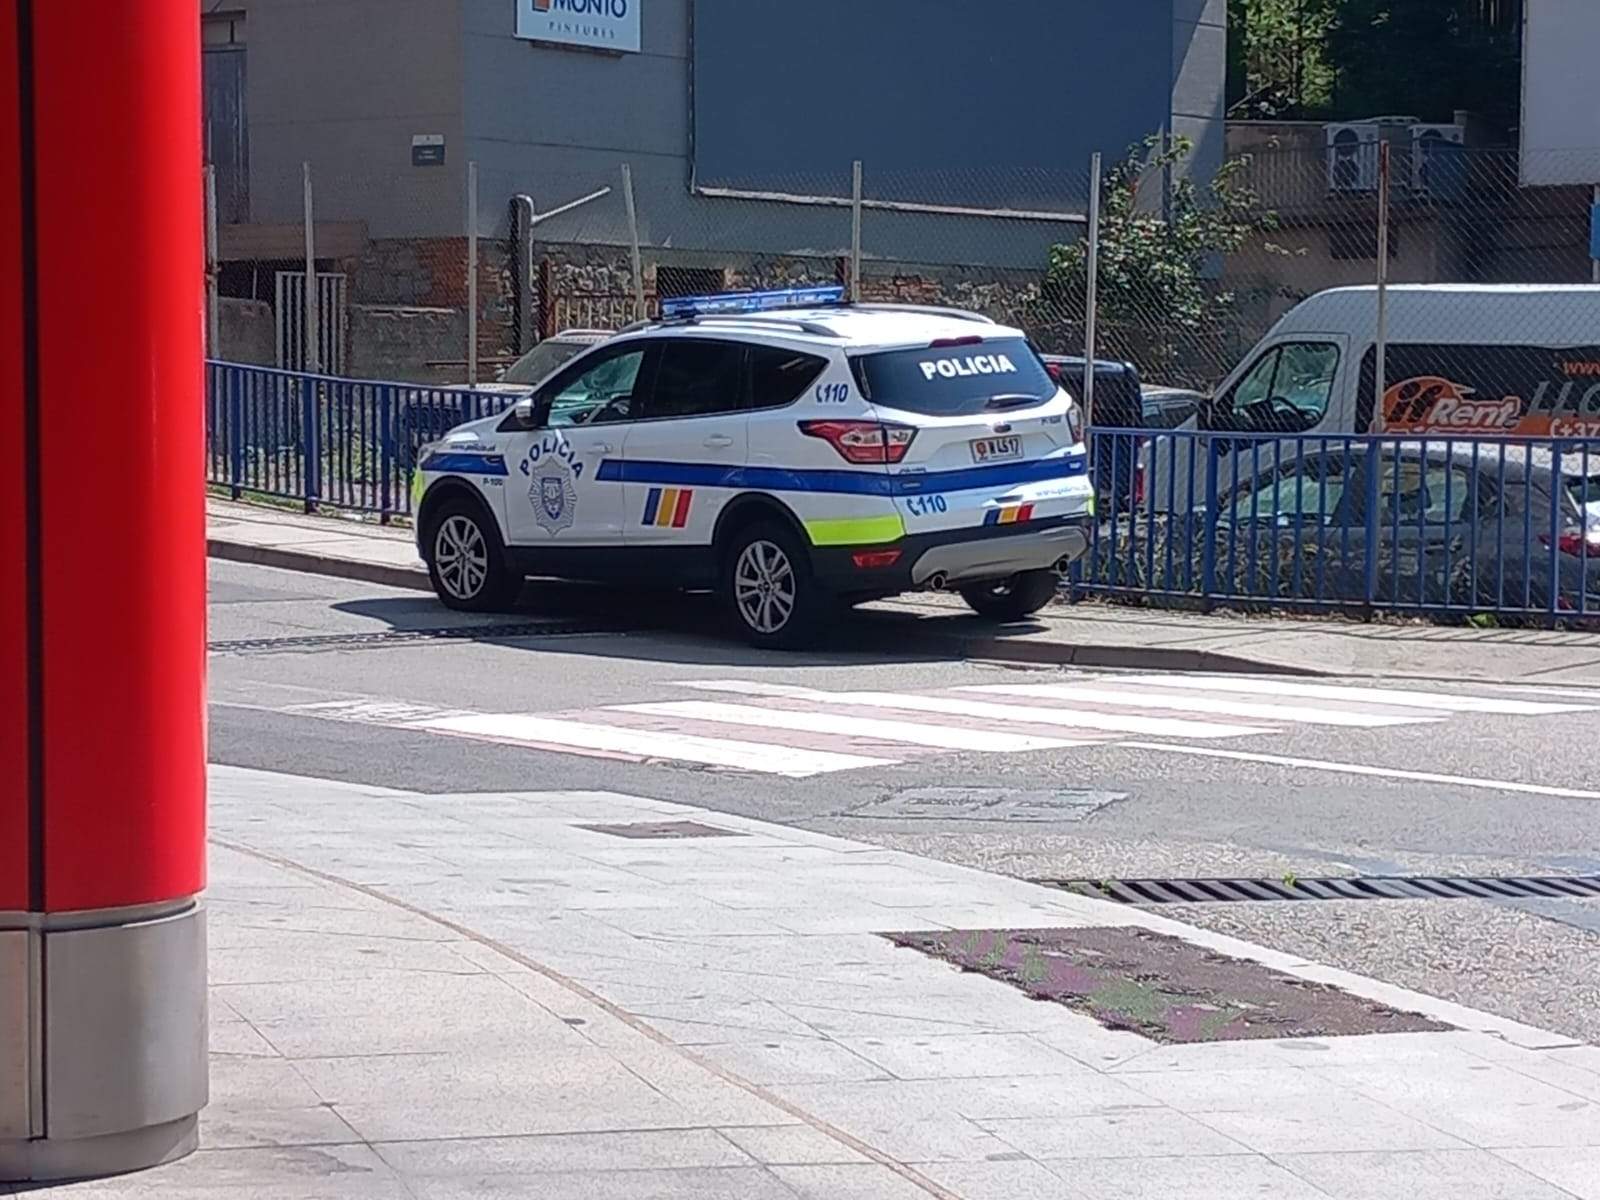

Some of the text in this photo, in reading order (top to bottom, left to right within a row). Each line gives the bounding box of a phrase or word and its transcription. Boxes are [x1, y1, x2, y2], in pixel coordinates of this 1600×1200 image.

[548, 22, 615, 39] PINTURES
[919, 354, 1017, 380] POLICIA
[1427, 398, 1519, 428] Rent
[519, 437, 584, 480] POLICIA
